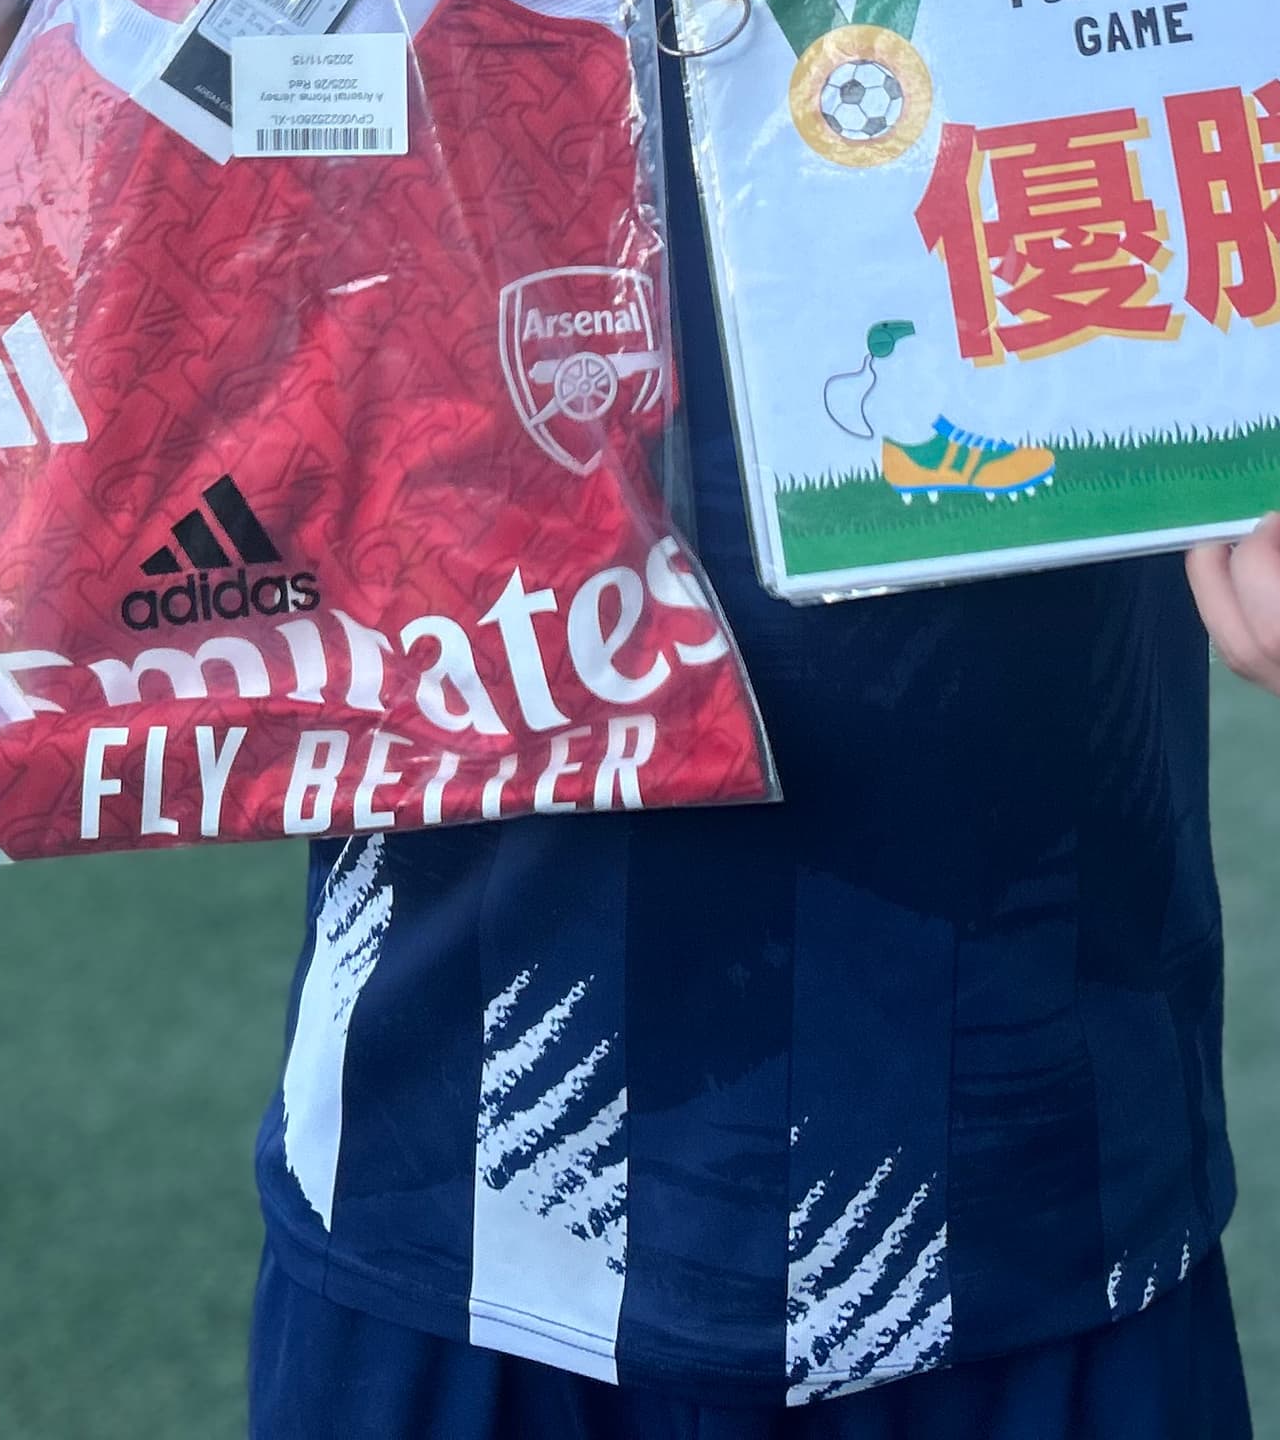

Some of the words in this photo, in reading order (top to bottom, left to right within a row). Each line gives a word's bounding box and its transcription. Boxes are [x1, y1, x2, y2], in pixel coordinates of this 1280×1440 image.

[1074, 2, 1193, 56] GAME
[260, 90, 295, 102] Jersey
[288, 78, 311, 89] Red
[299, 92, 332, 102] Home
[334, 92, 375, 102] Arsenal
[522, 302, 641, 342] Arsenal
[121, 569, 320, 631] adidas
[80, 726, 248, 839] FLY
